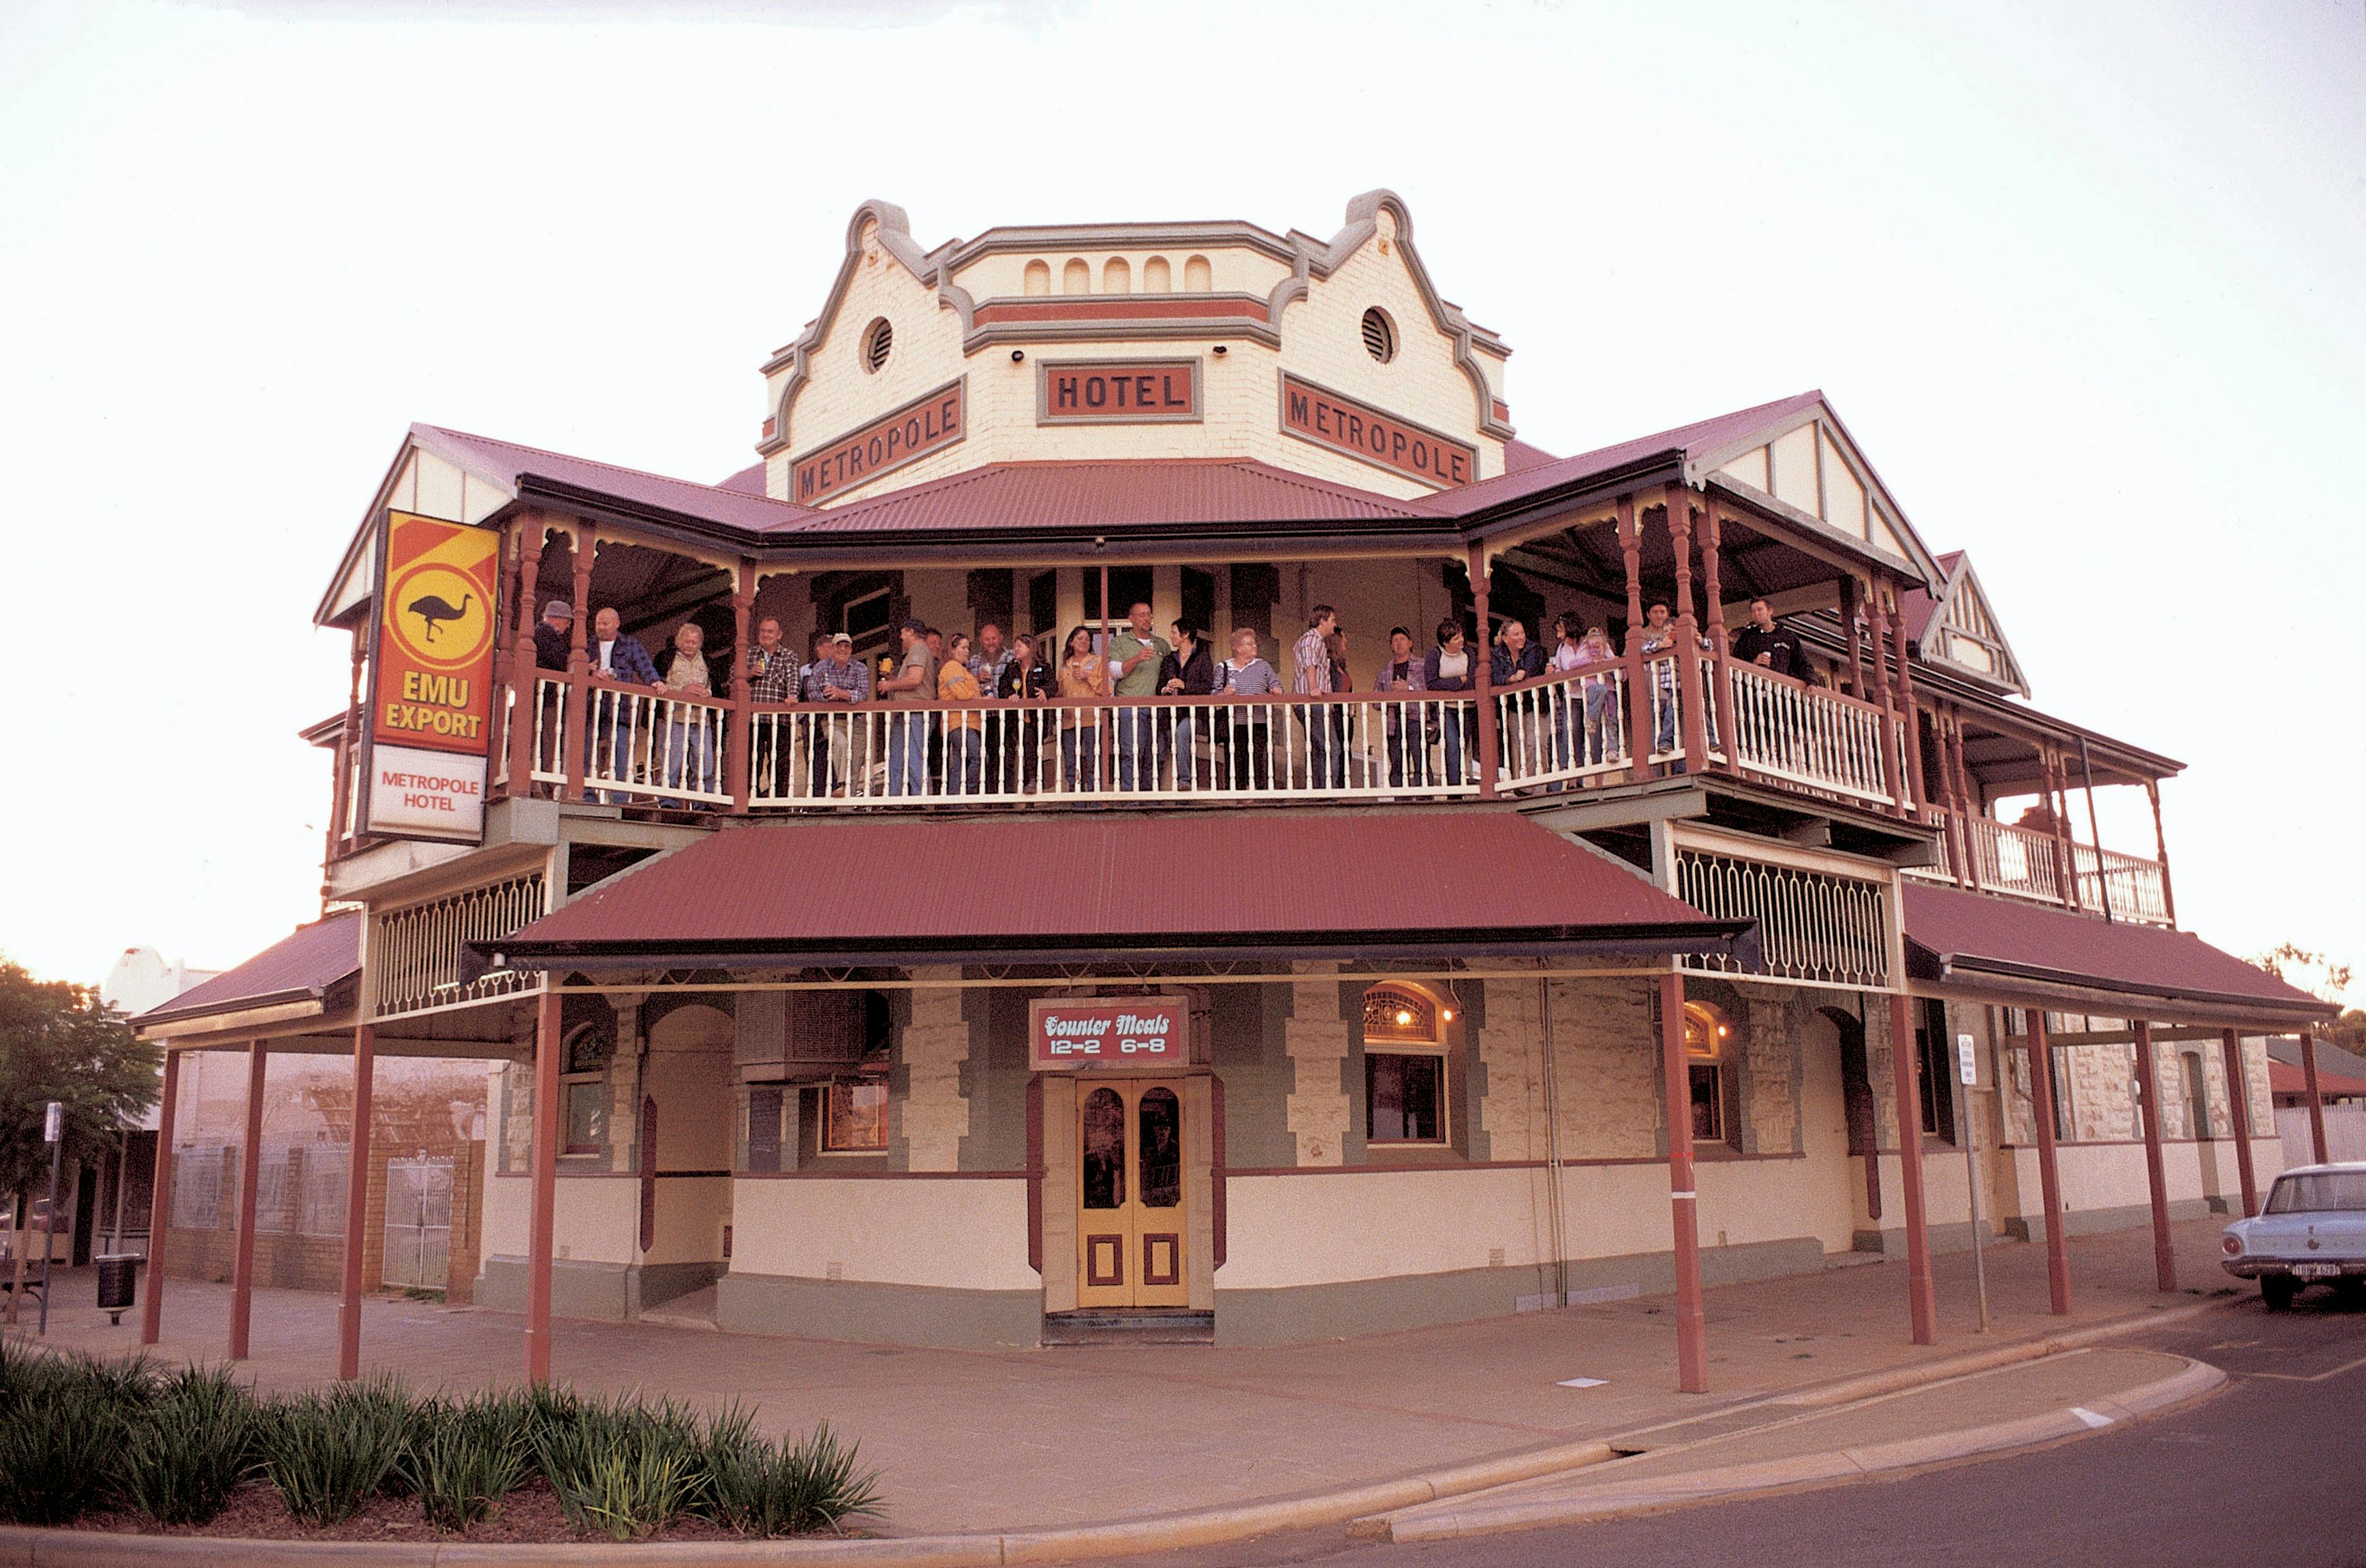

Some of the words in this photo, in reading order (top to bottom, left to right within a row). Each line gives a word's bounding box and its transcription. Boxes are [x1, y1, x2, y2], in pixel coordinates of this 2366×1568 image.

[1057, 375, 1186, 409] HOTEL
[800, 398, 958, 499] METROPOLE
[1290, 391, 1466, 485] METROPOLE
[403, 670, 469, 708] EMU
[386, 703, 481, 738] EXPORT
[382, 771, 480, 796] METROPOLE
[404, 793, 456, 812] HOTEL
[1044, 1016, 1112, 1036] Counter
[1115, 1014, 1170, 1035] Meals
[1050, 1039, 1101, 1054] 12-2
[1120, 1038, 1166, 1053] 6-8
